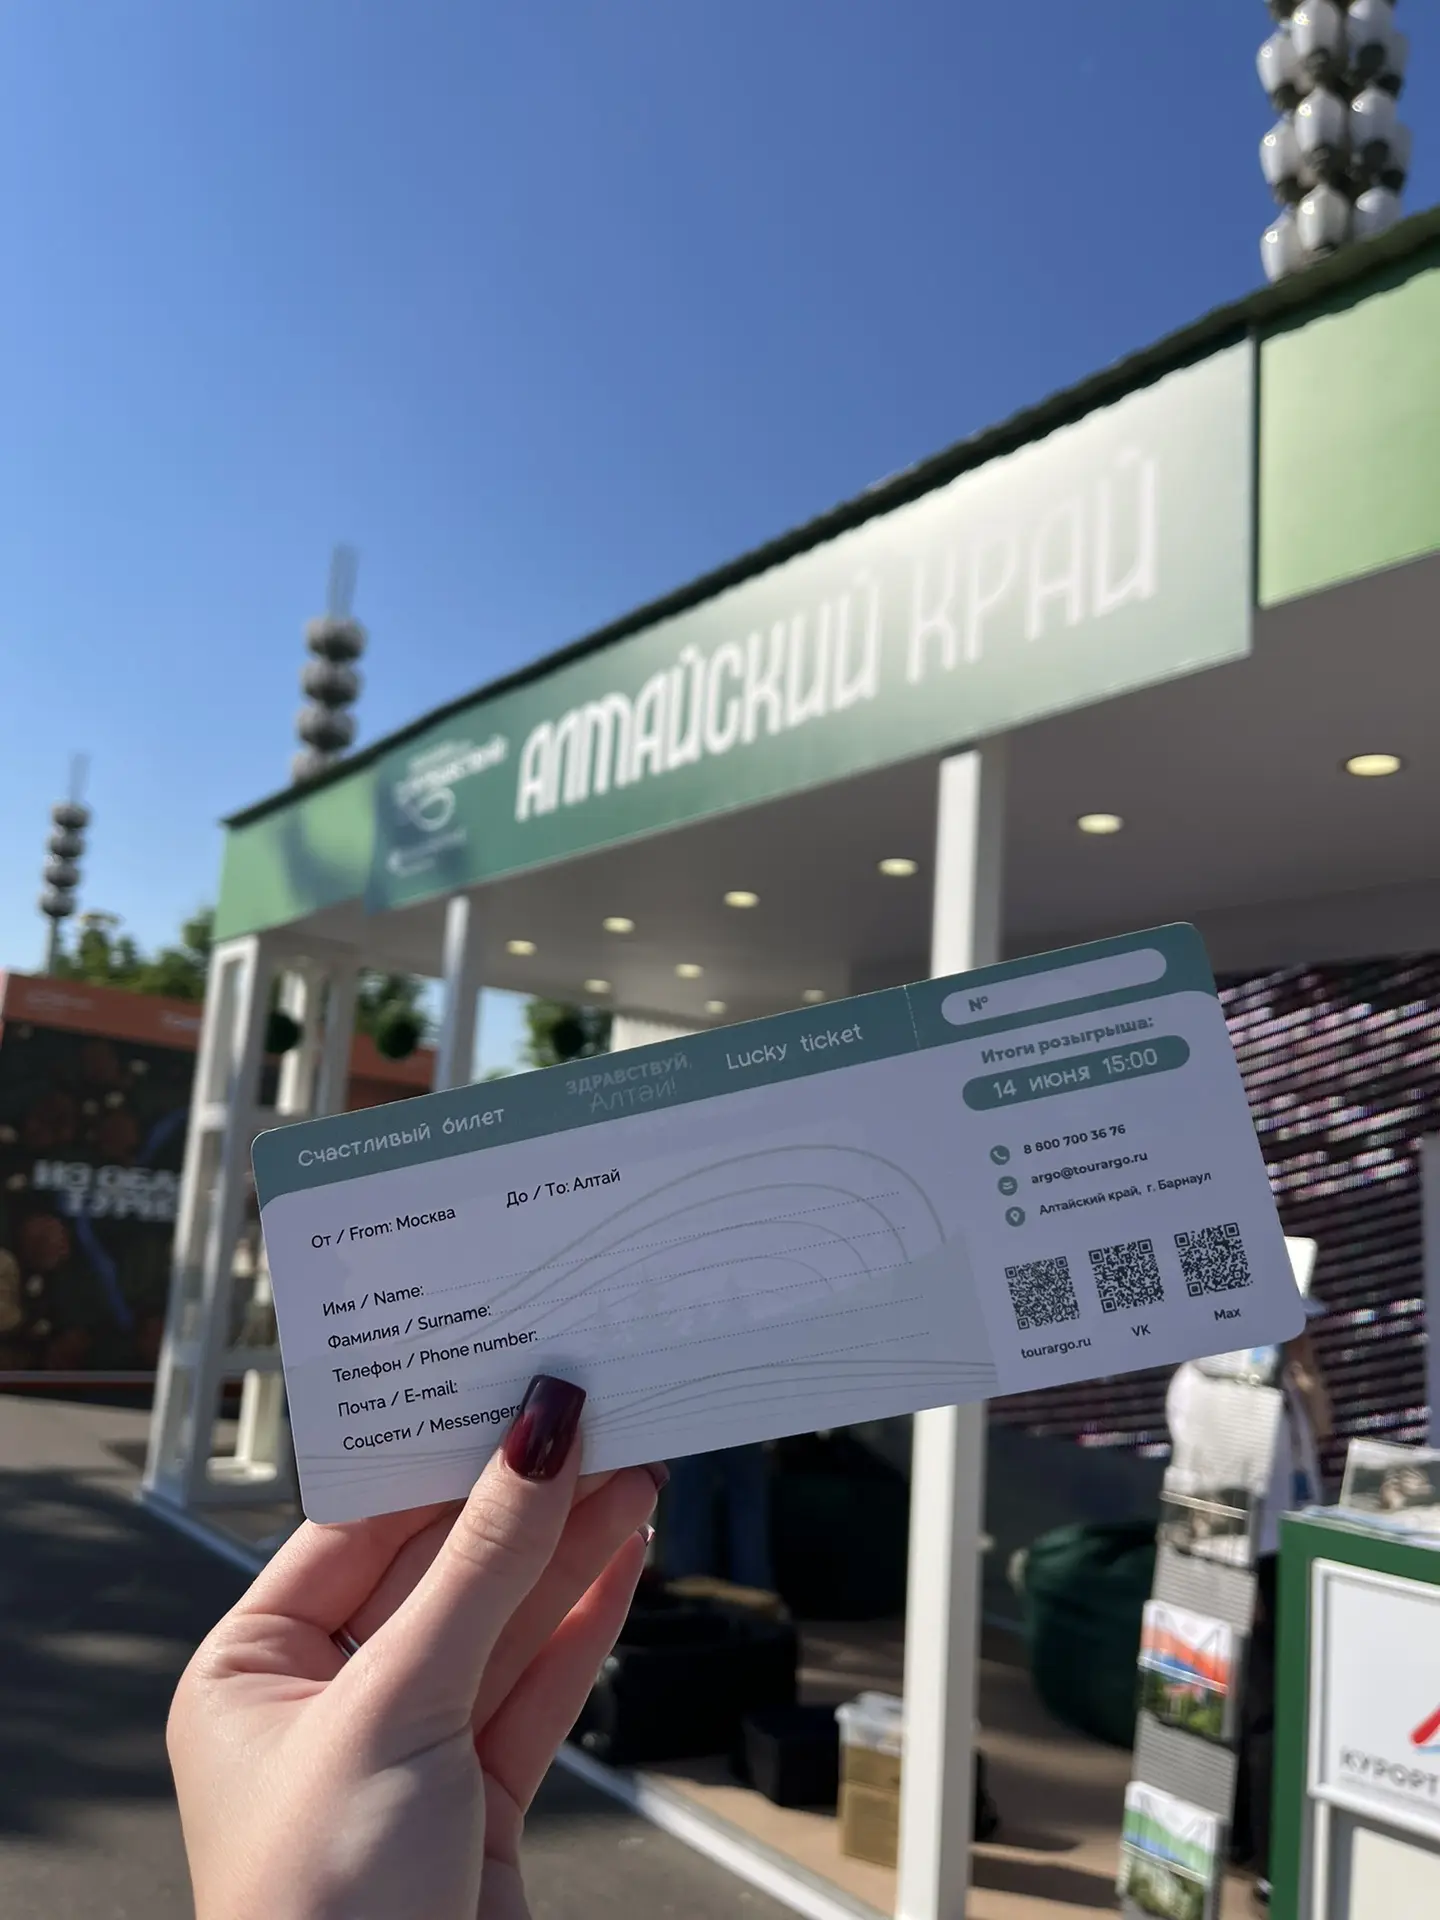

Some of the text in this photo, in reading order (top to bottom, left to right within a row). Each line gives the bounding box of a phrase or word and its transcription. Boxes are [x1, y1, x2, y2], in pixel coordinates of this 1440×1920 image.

[515, 446, 1160, 823] АЛТАЙСКИЙ КРАЙ
[725, 1023, 863, 1070] Lucky ticket
[981, 1017, 1155, 1065] Итоги розыгрыша:
[993, 1078, 1018, 1099] 14
[1102, 1047, 1159, 1075] 15:00
[298, 1108, 505, 1167] Счастливый билет
[1023, 1124, 1126, 1155] 8 800 700 36 76
[506, 1191, 529, 1208] До
[545, 1182, 570, 1197] To:
[573, 1168, 621, 1191] Алтай
[1031, 1151, 1149, 1185] argo@tourargo.ru
[1039, 1192, 1106, 1216] Алтайский
[1146, 1183, 1157, 1194] г.
[1157, 1172, 1212, 1191] Барнаул
[311, 1235, 332, 1249] От
[350, 1221, 394, 1241] From:
[396, 1208, 456, 1231] Москва
[322, 1300, 356, 1317] Имя
[373, 1285, 425, 1306] Name:
[1214, 1307, 1242, 1321] Max
[328, 1323, 400, 1350] Фамилия
[418, 1305, 491, 1331] Surname:
[1131, 1323, 1152, 1338] VK
[332, 1358, 402, 1383] Телефон
[420, 1345, 470, 1366] Phone
[473, 1329, 538, 1355] number:
[1021, 1337, 1092, 1360] tourargo.ru
[338, 1397, 387, 1418] Почта
[404, 1380, 459, 1404] E-mail:
[342, 1427, 412, 1451] Соцсети
